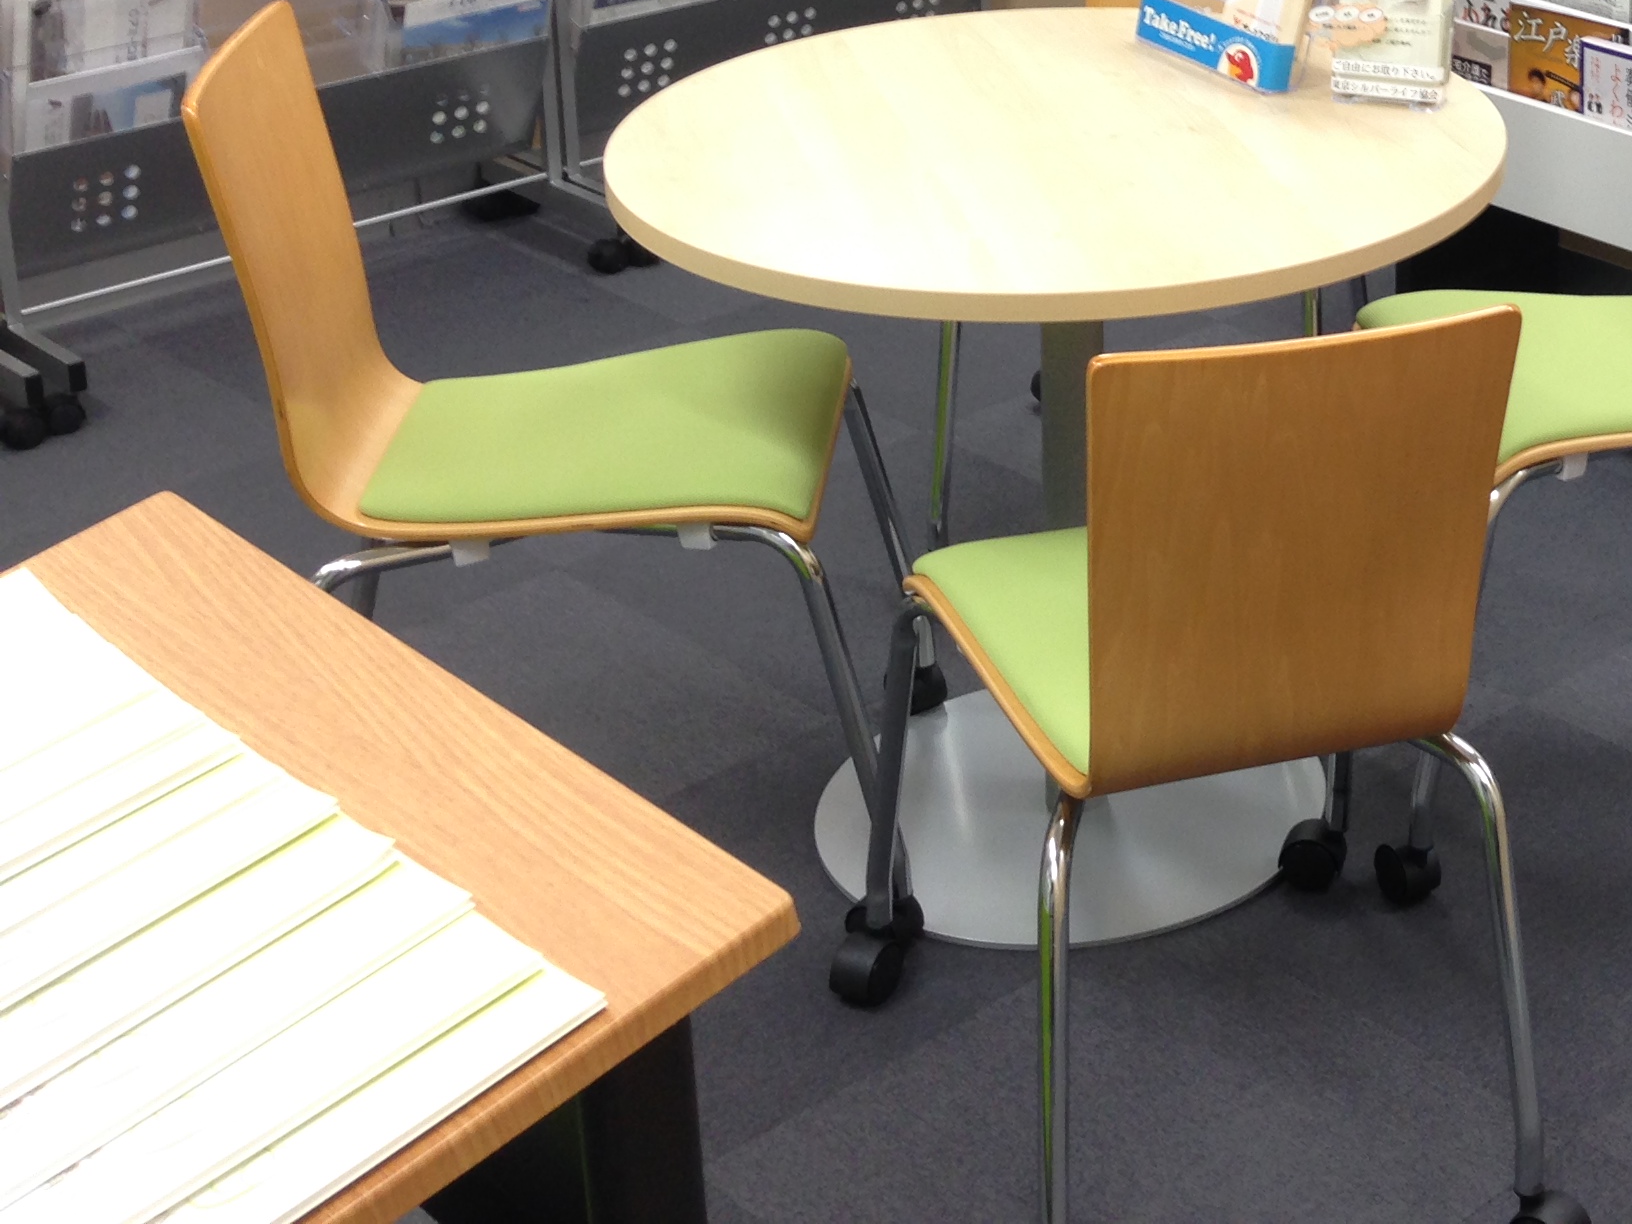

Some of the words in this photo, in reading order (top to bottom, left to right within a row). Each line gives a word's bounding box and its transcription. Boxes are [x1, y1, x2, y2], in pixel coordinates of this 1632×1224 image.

[1143, 5, 1178, 34] Take
[1178, 19, 1217, 53] Free!
[1334, 59, 1436, 81] ご自由にお取り下さい。
[1333, 79, 1439, 100] 東京シルバーライフ協会
